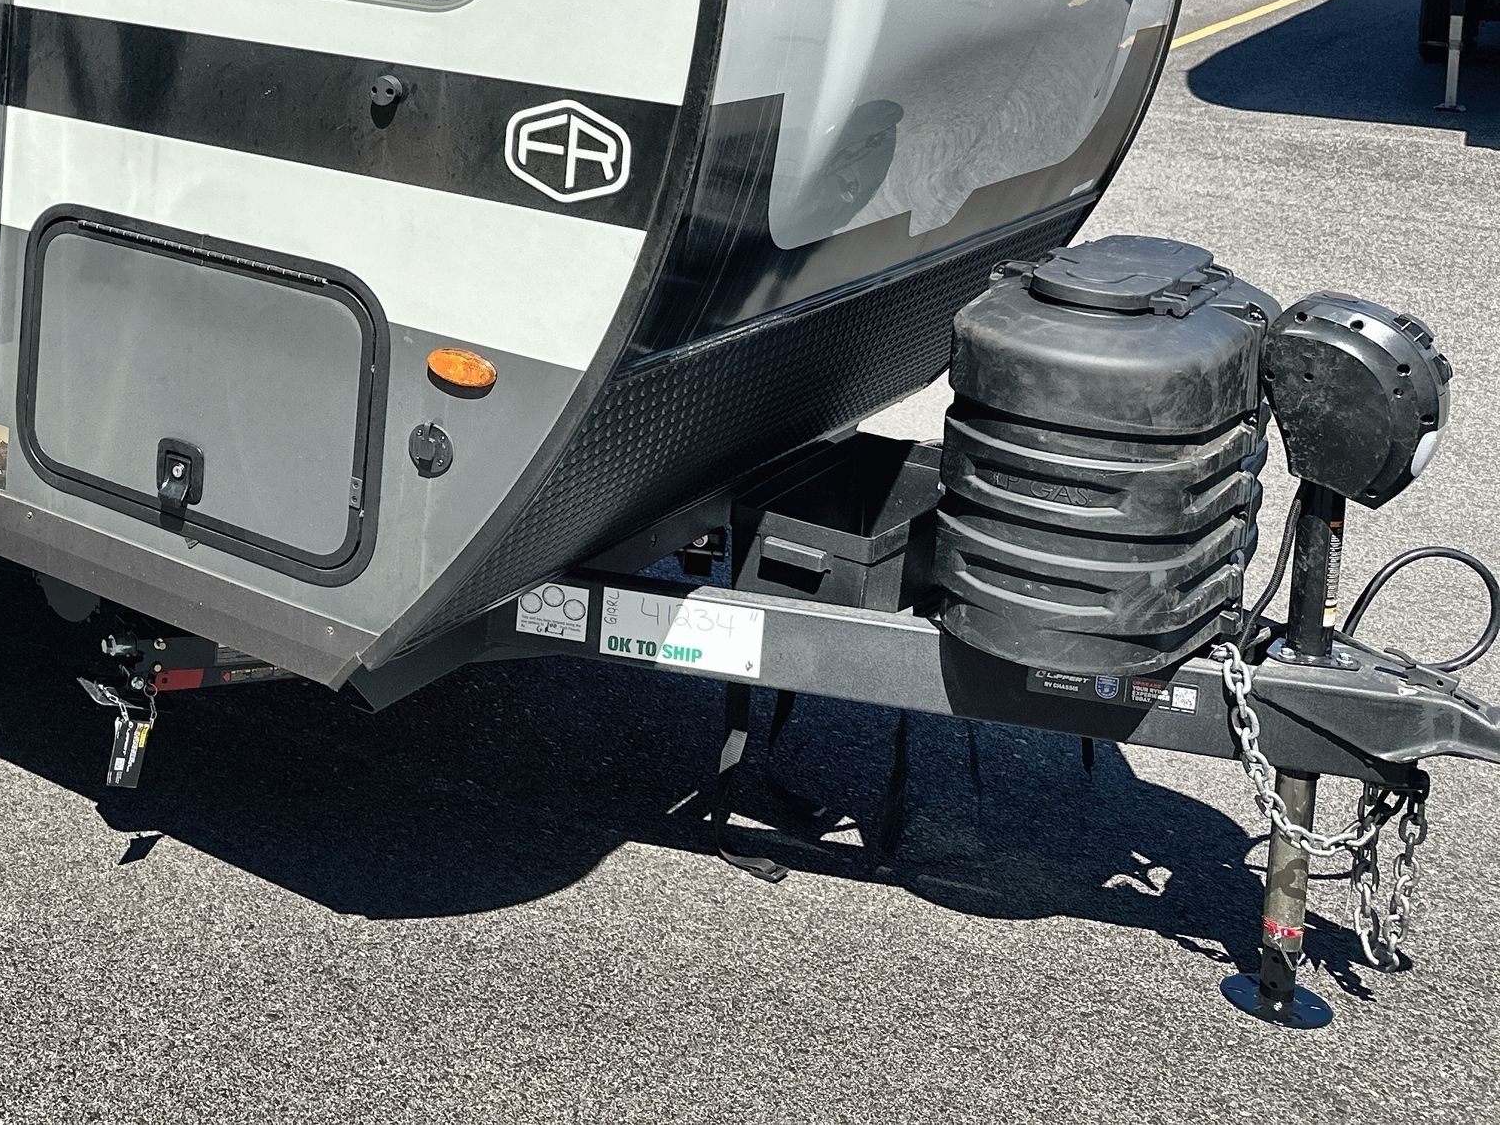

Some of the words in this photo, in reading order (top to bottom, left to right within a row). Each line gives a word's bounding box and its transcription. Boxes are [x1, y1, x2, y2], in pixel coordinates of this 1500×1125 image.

[1030, 480, 1088, 506] GAS
[608, 635, 631, 653] OK
[636, 639, 656, 656] TO
[662, 644, 702, 663] SHIP
[1053, 682, 1079, 692] CHASSIS
